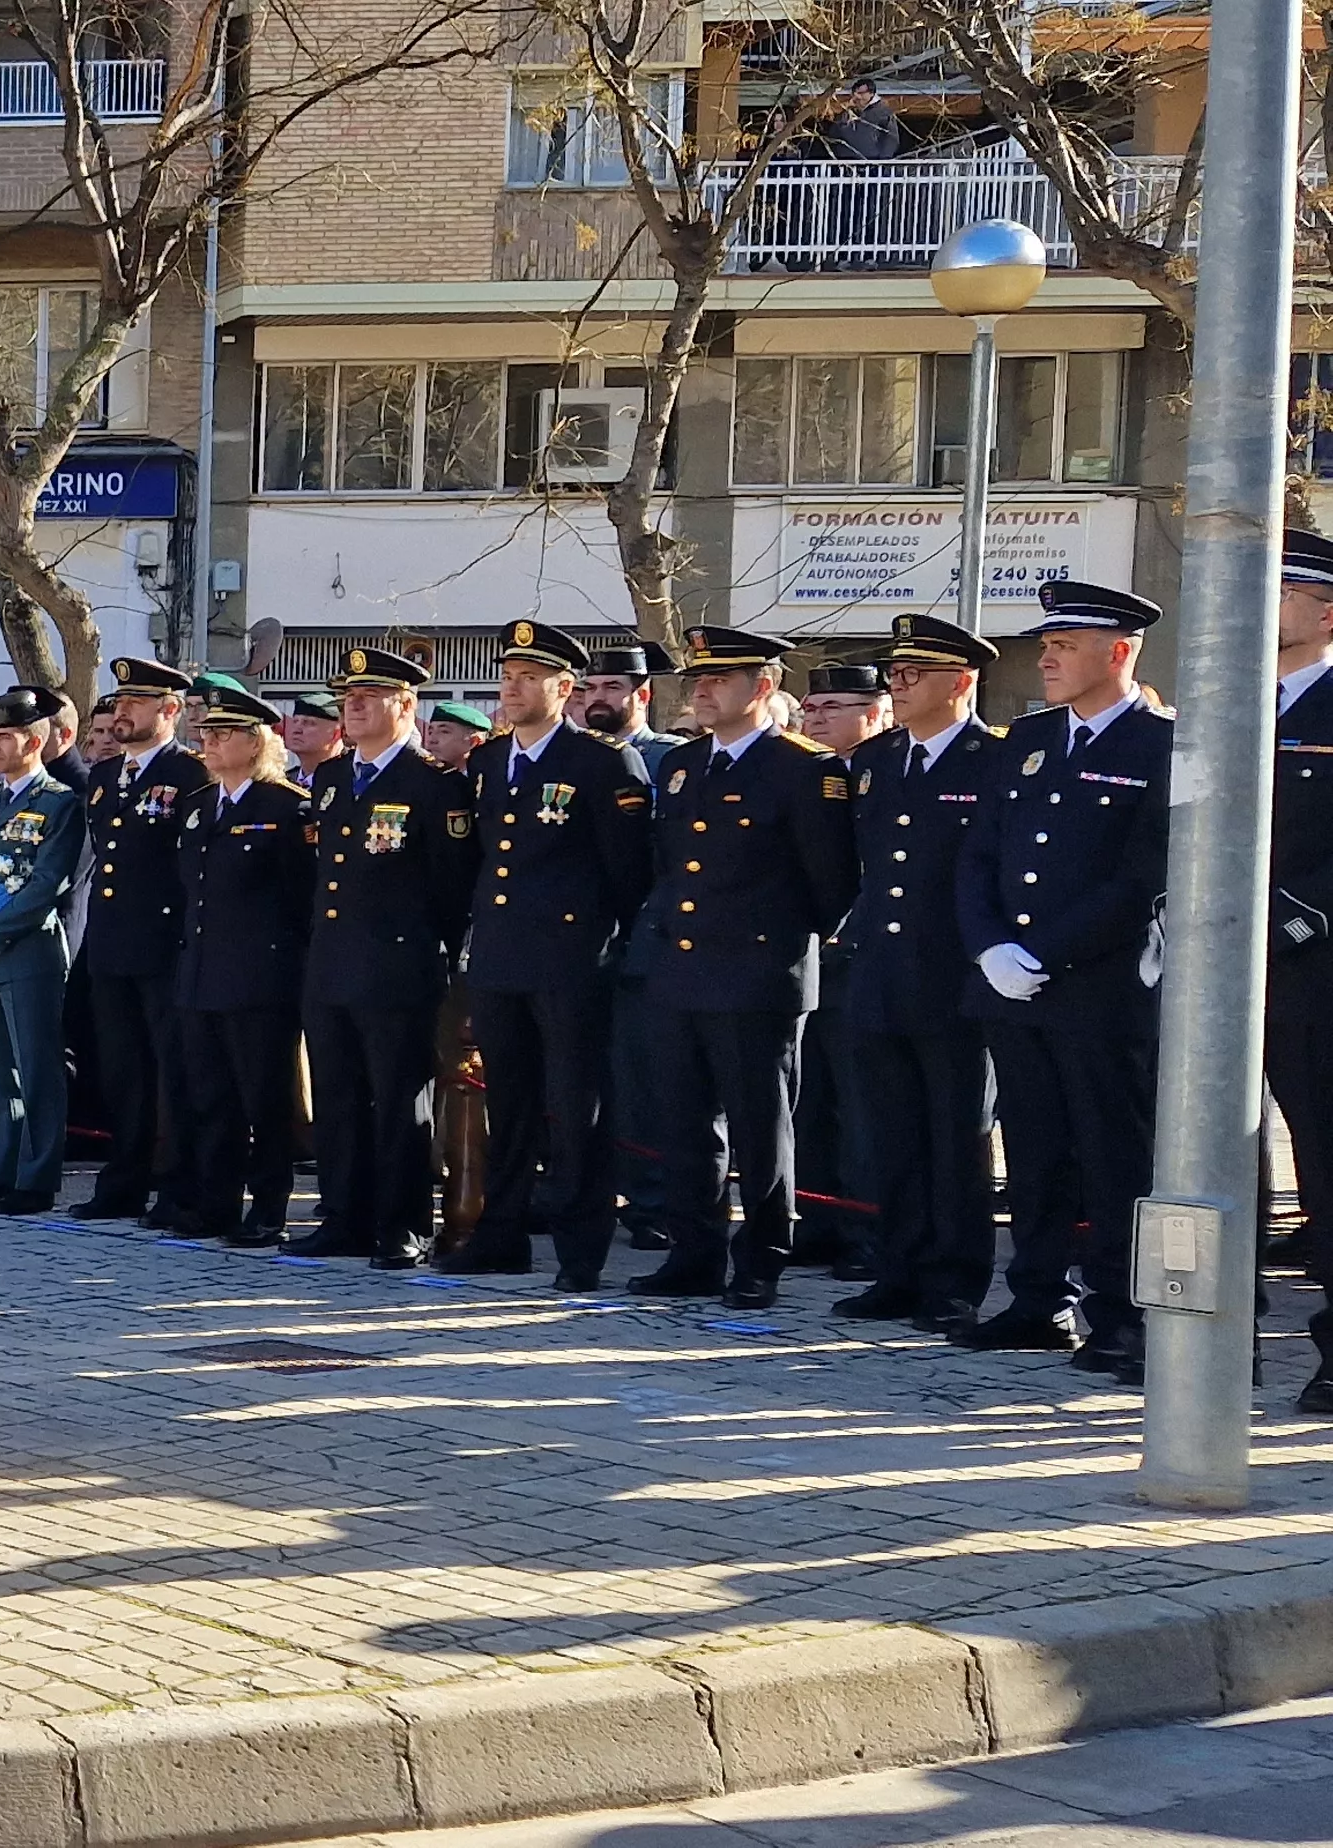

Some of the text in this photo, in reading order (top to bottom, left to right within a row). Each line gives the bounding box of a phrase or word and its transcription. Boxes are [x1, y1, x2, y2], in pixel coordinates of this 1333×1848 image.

[42, 472, 124, 495] ARINO
[35, 500, 87, 512] PEZ XXI
[792, 509, 1080, 527] FORMACIÓN ATUITA
[809, 536, 920, 547] DESEMPLEADOS
[984, 533, 1046, 545] nfórmate
[808, 552, 916, 563] TRABAJADORES
[806, 566, 898, 580] AUTÓNOMOS
[992, 565, 1069, 581] 240 305
[795, 586, 915, 599] www.cescio.com
